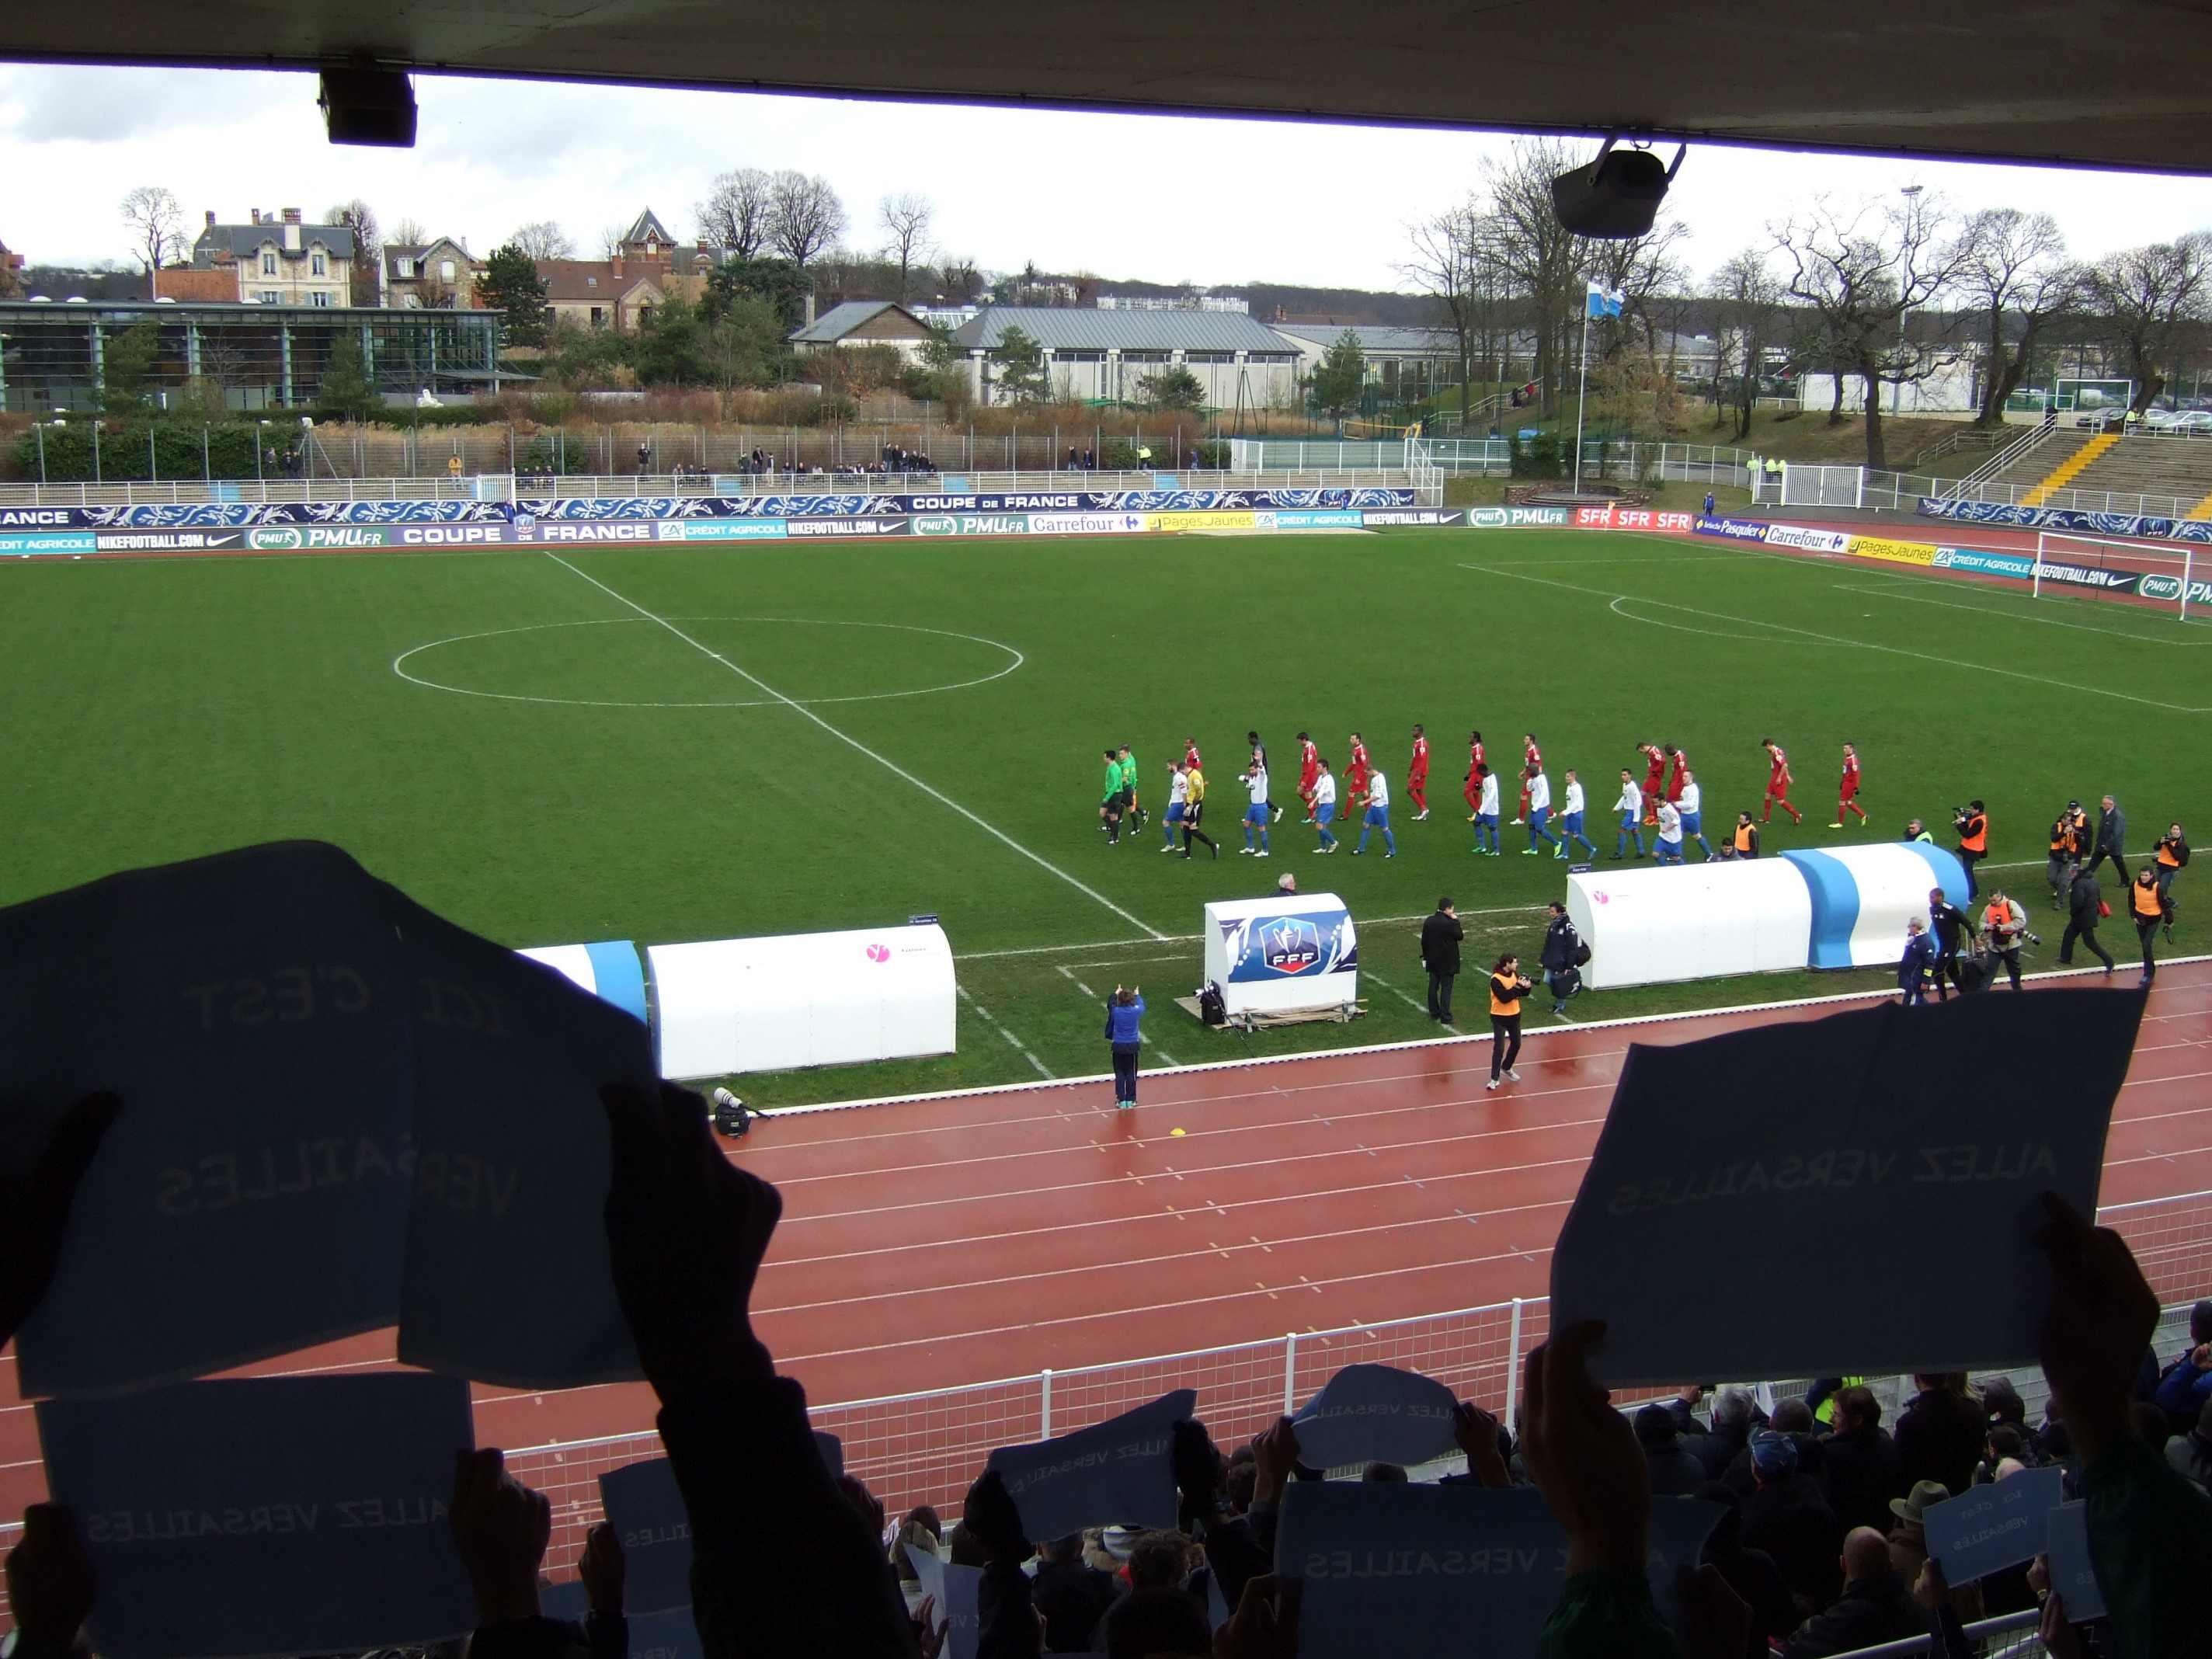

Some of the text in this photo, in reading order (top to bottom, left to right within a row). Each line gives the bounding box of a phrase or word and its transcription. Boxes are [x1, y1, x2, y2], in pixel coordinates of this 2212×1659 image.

[913, 496, 1078, 510] COUPE DE FRANCE
[0, 511, 69, 524] ANCE
[1034, 516, 1114, 533] Carrefour
[1363, 512, 1438, 525] NIKEFOOTBALL.COM
[1476, 513, 1496, 523] PMU
[1580, 510, 1689, 529] SFR SFR SFR
[729, 524, 785, 535] AGRICOLE
[788, 521, 877, 535] NIKEFOOTBALL.COM
[920, 521, 943, 530] PMU
[1720, 520, 1759, 537] Pasquier
[257, 533, 283, 544] PMU
[404, 527, 501, 543] COUPE
[544, 524, 650, 542] FRANCE
[1769, 527, 1827, 548] Carrefour
[26, 539, 95, 550] AGRICOLE
[97, 534, 203, 550] NIKEFOOTBALL.COM
[1984, 558, 2030, 573] AGRICOLE
[2029, 563, 2108, 586] NKEFOOTBALL.COM
[2145, 579, 2167, 593] PMU
[1272, 952, 1315, 966] FFF
